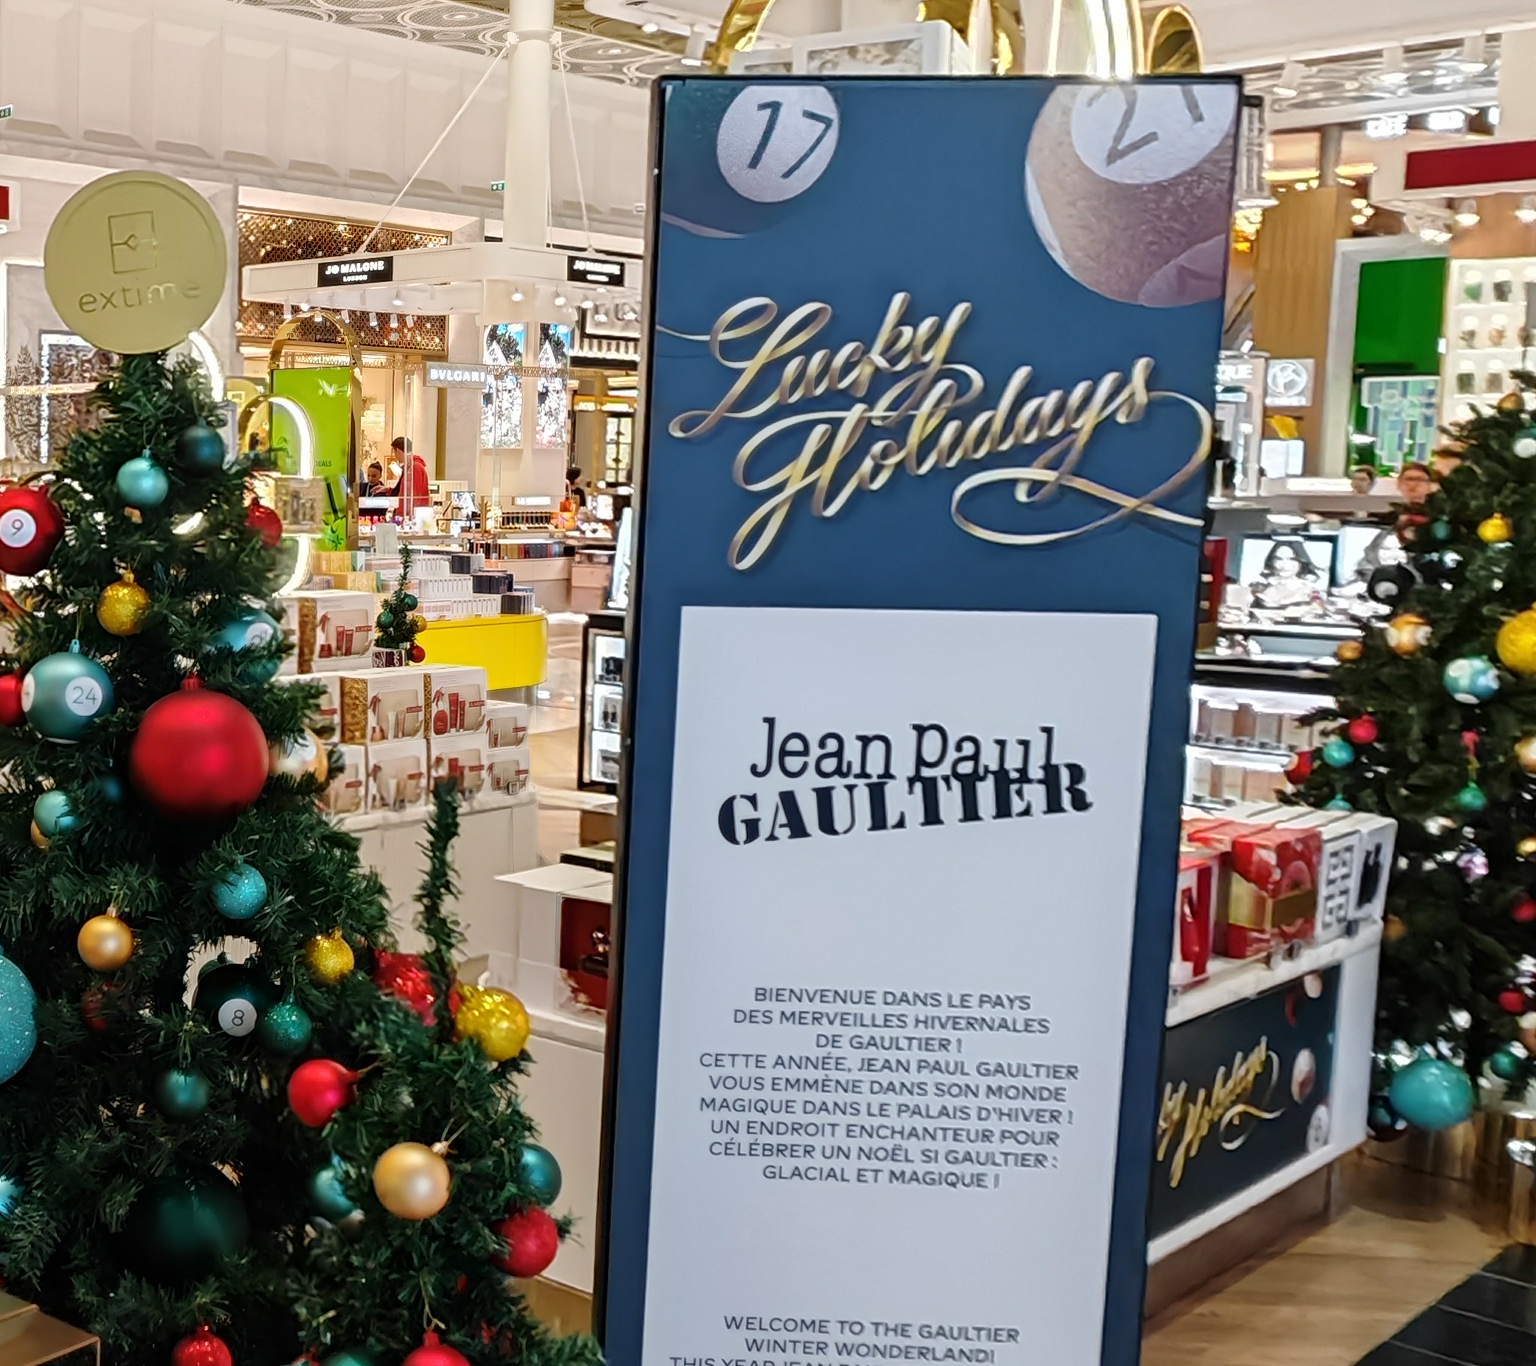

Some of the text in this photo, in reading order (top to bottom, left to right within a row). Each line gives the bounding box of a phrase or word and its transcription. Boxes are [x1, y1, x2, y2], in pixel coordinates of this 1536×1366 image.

[749, 100, 834, 178] 17
[340, 261, 384, 273] MALONE
[79, 278, 200, 313] extime
[430, 368, 486, 383] BVLGARI
[669, 290, 984, 438] Lucky
[731, 357, 1211, 571] Holidays
[11, 519, 25, 538] 9
[72, 686, 98, 706] 24
[749, 716, 1061, 782] Jean Paul
[718, 761, 1094, 847] GAULTIER
[754, 987, 1031, 1011] BIENVENUE DANS LE PAYS
[231, 1009, 245, 1027] 8
[733, 1008, 1051, 1034] DES MERVEILLES HIVERNALES
[815, 1033, 843, 1049] DE
[849, 1034, 952, 1053] GAULTIER
[699, 1052, 1079, 1080] CETTE ANNÉE, JEAN PAUL GAULTIER
[708, 1075, 1067, 1102] VOUS EMMÈNE DANS SON MONDE
[699, 1097, 797, 1115] MAGIQUE
[802, 1099, 861, 1117] DANS
[866, 1102, 891, 1118] LE
[895, 1103, 971, 1121] PALAIS
[976, 1106, 1063, 1124] D'HIVER
[710, 1119, 1060, 1147] UN ENDROIT ENCHANTEUR POUR
[708, 1137, 816, 1159] CÉLÉBRER
[821, 1145, 851, 1160] UN
[856, 1143, 915, 1163] NOËL
[920, 1148, 939, 1164] SI
[944, 1149, 1049, 1168] GAULTIER
[761, 1164, 851, 1183] GLACIAL
[855, 1167, 884, 1184] ET
[887, 1169, 989, 1189] MAGIQUE
[723, 1315, 1020, 1343] WELCOME TO THE GAULTIER
[744, 1338, 995, 1363] WINTER WONDERLAND!
